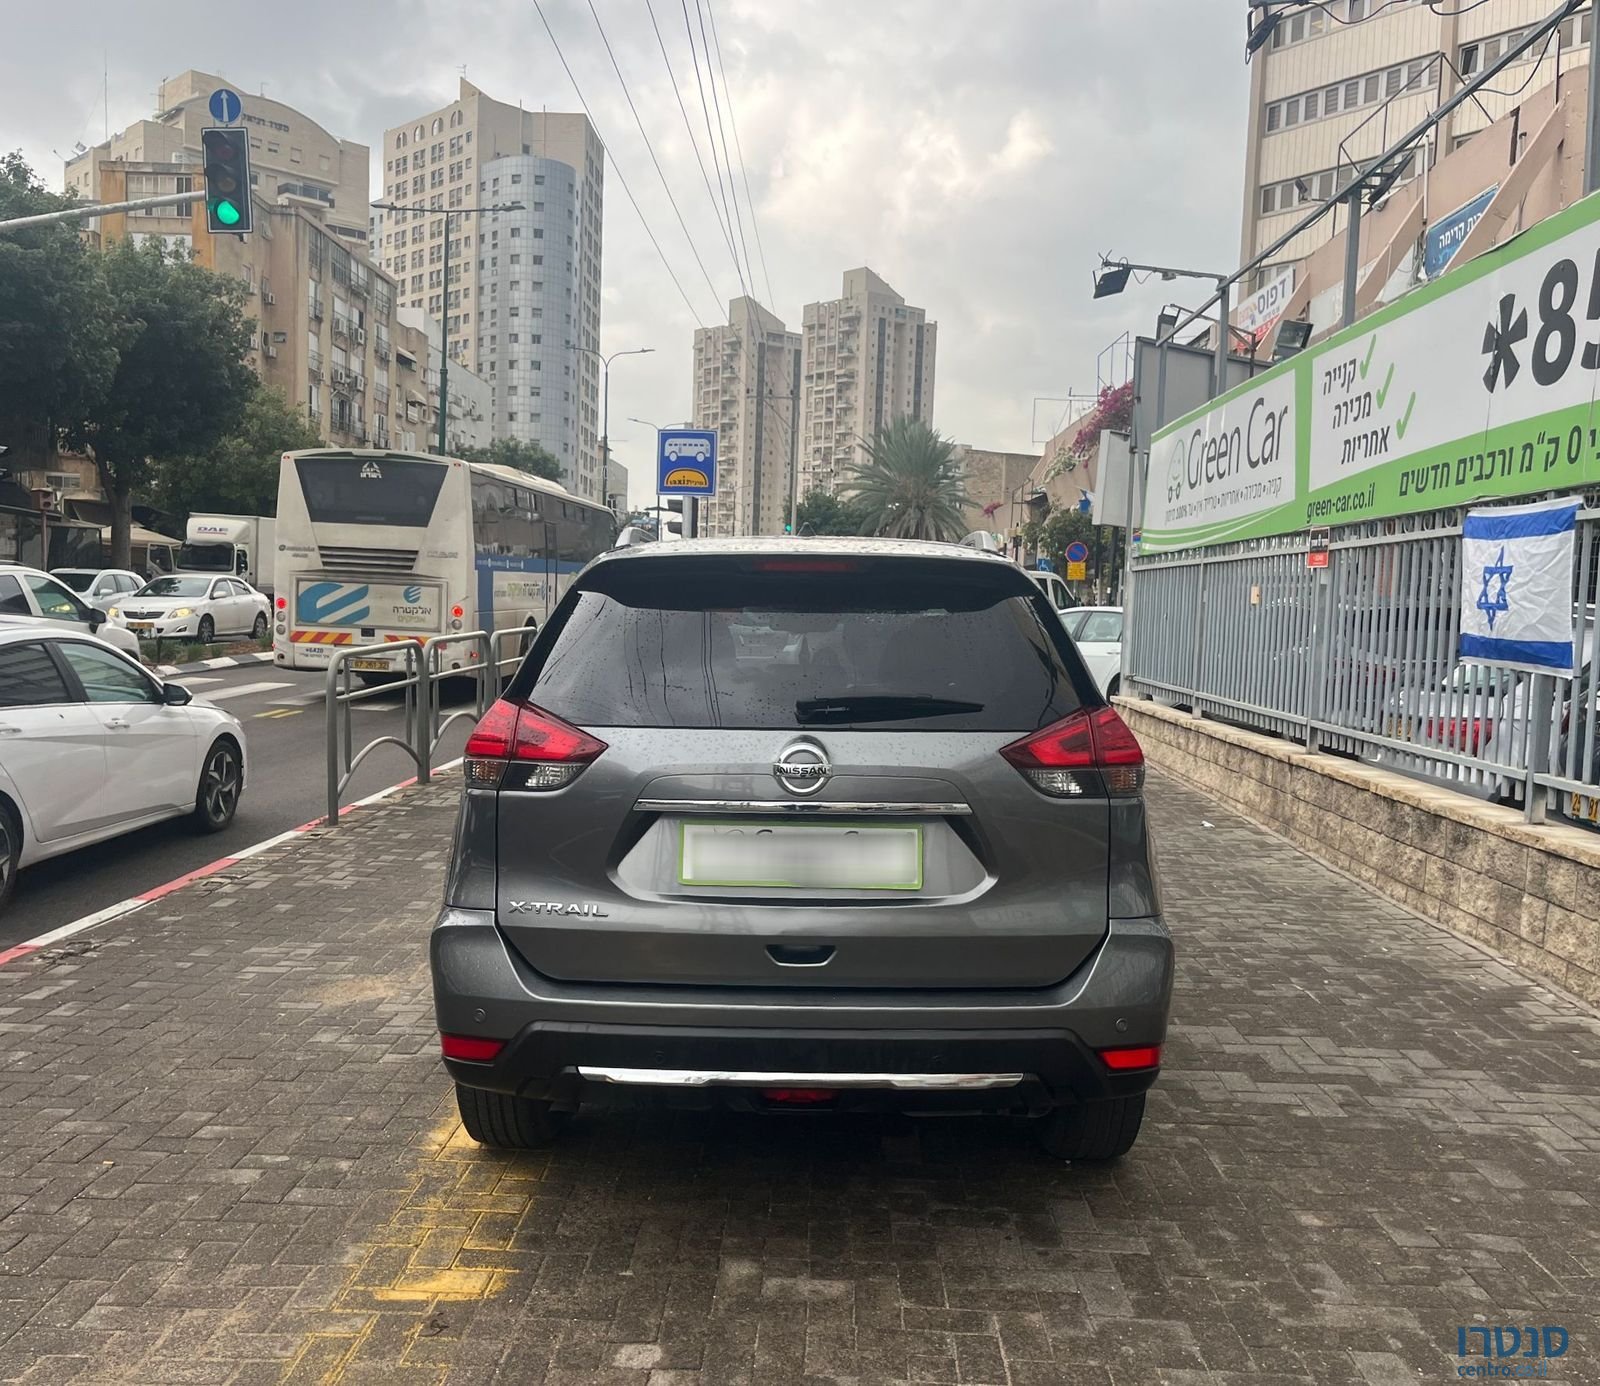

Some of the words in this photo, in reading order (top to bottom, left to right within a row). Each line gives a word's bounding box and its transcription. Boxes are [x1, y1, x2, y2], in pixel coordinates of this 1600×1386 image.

[1439, 222, 1465, 249] קדימה
[1257, 278, 1287, 315] דפוס
[1323, 358, 1357, 395] קנייה
[1332, 391, 1372, 429] מכירה
[1187, 426, 1241, 490] Green
[1247, 397, 1288, 469] Car
[1341, 425, 1391, 465] אחריות
[1567, 425, 1582, 465] 0
[670, 475, 686, 485] taxi
[1399, 462, 1450, 497] חדשים
[1455, 446, 1514, 486] ורכבים
[1306, 482, 1376, 524] green-car.co.il
[392, 606, 432, 615] אלקטרה
[777, 766, 827, 776] NISSAN
[508, 901, 609, 917] X-TRAIL
